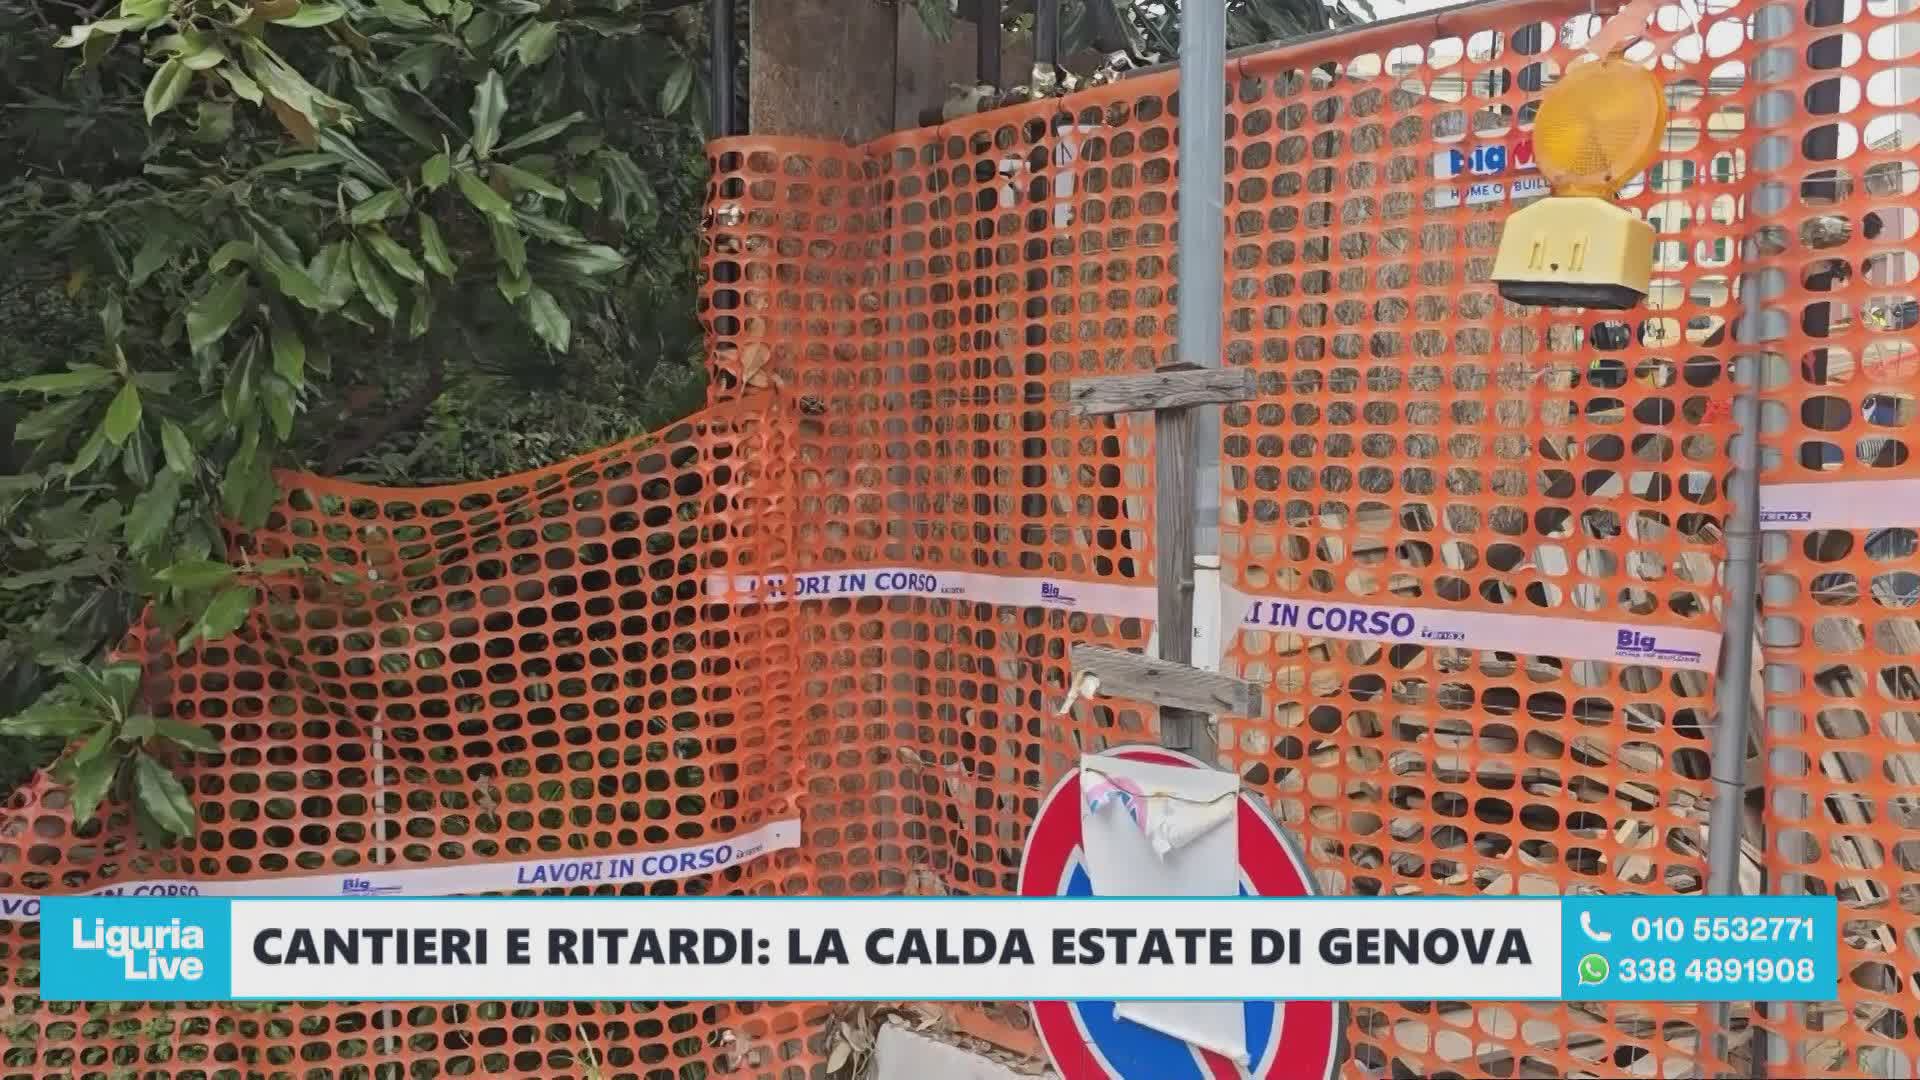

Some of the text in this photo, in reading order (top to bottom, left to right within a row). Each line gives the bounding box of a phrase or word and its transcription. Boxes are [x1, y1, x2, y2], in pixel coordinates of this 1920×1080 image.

[838, 573, 866, 592] IN
[875, 572, 937, 593] CORSO
[1269, 603, 1299, 627] IN
[1307, 606, 1415, 637] CORSO
[1617, 629, 1656, 652] Big
[517, 861, 602, 884] LAVORI
[608, 859, 635, 878] IN
[642, 845, 732, 876] CORSO
